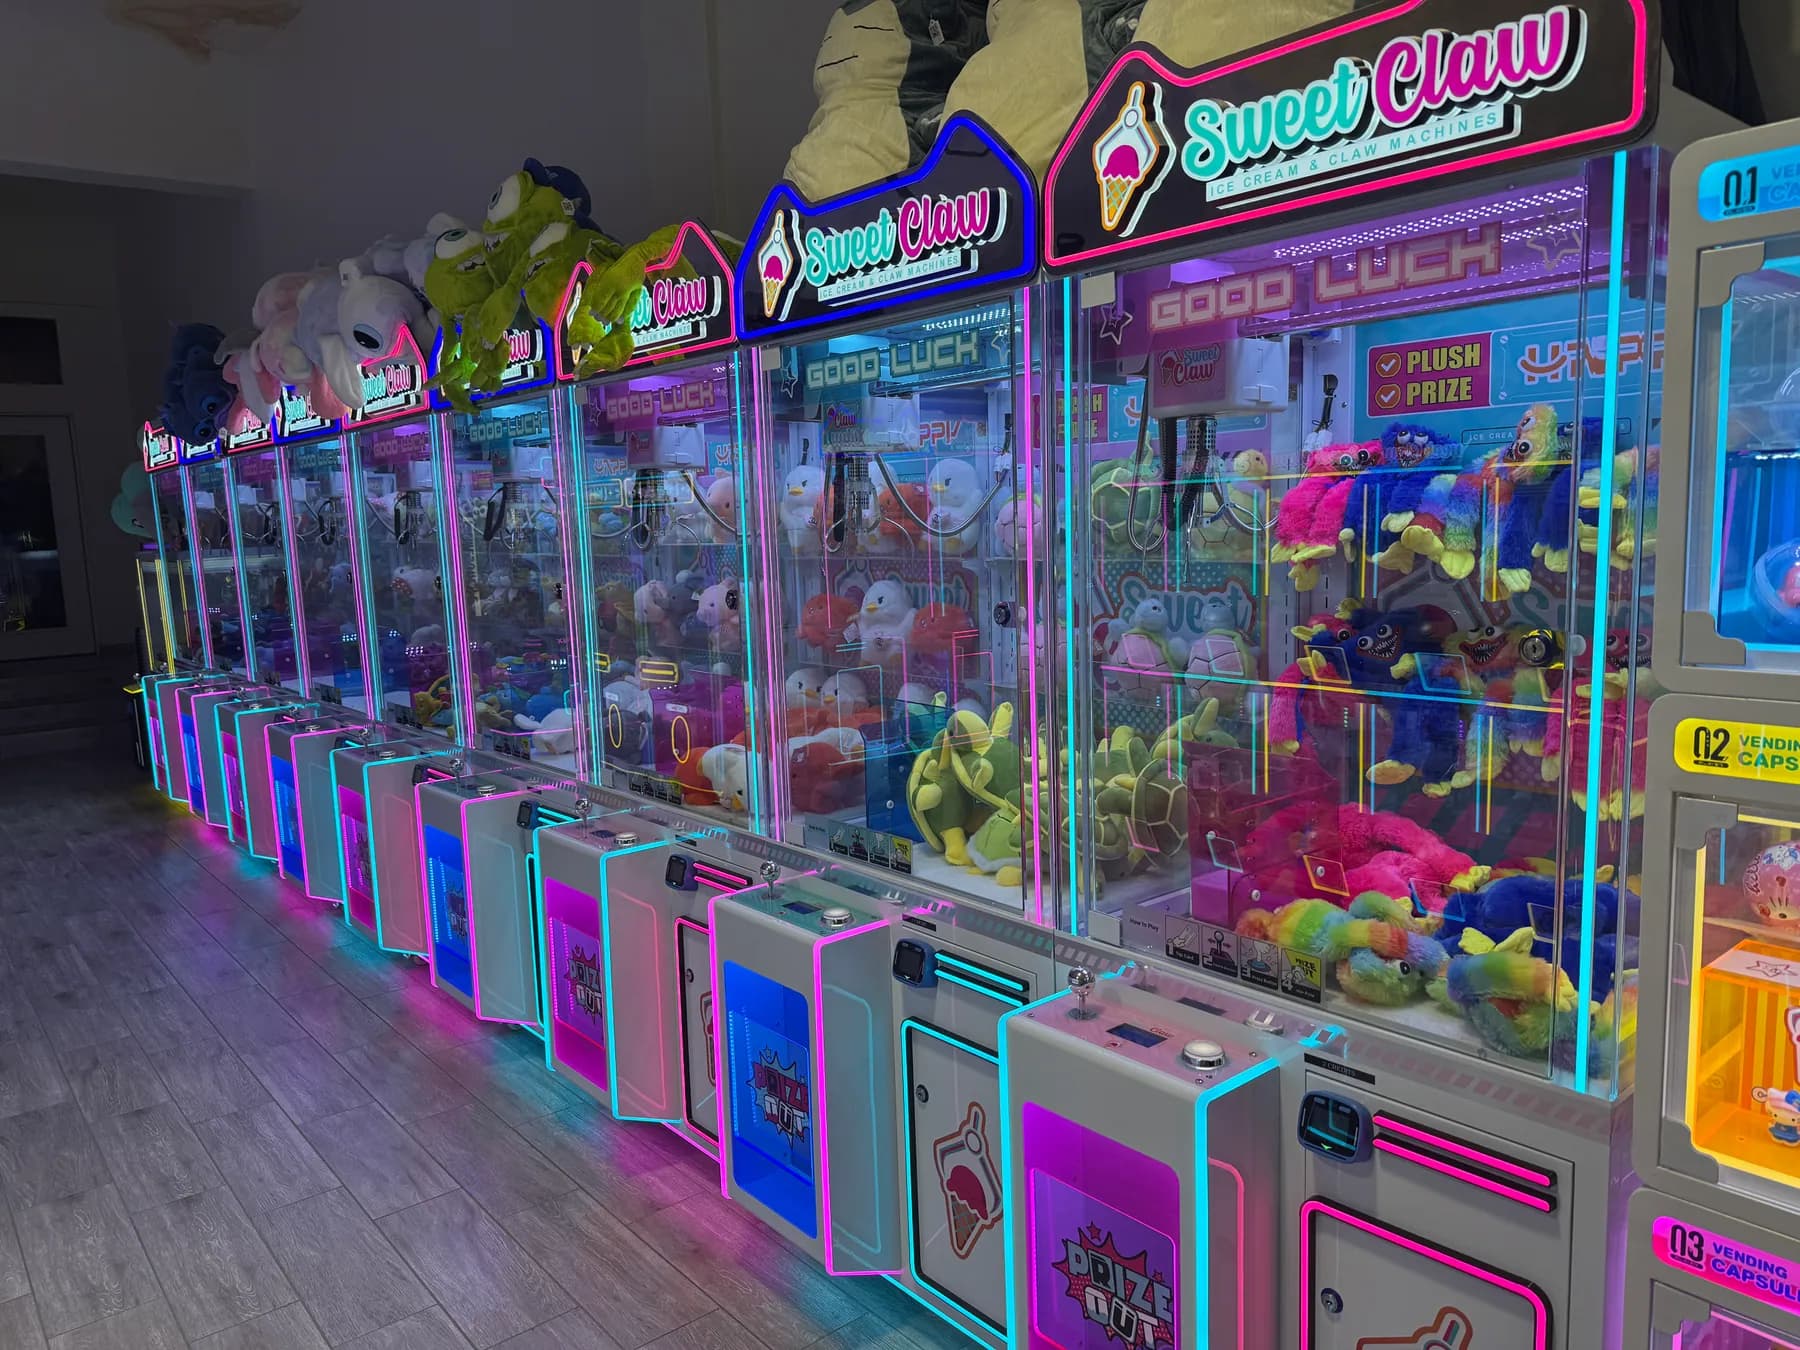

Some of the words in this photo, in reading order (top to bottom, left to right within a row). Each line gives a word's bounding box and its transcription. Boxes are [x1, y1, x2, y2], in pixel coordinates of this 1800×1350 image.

[1182, 57, 1367, 181] Sweet
[1373, 5, 1573, 126] Claw
[1210, 181, 1234, 197] ICE
[1243, 164, 1299, 187] CREAM
[1309, 159, 1319, 171] &
[1328, 143, 1378, 166] CLAW
[1389, 112, 1497, 151] MACHINES
[1723, 165, 1758, 208] 01
[805, 208, 896, 287] Sweet
[899, 187, 991, 261] Claw
[819, 289, 833, 299] ICE
[836, 280, 865, 294] CREAM
[878, 271, 902, 283] CLAW
[907, 255, 960, 276] MACHINES
[1149, 264, 1295, 331] GOOD
[1314, 223, 1503, 302] LUCK
[653, 276, 707, 328] Claw
[805, 350, 881, 389] GOOD
[889, 329, 980, 379] LUCK
[1171, 362, 1217, 386] Claw
[1183, 344, 1222, 366] Sweet
[1406, 341, 1482, 374] PLUSH
[1406, 376, 1474, 406] PRIZE
[1488, 430, 1514, 441] CREA
[1693, 726, 1730, 762] 02
[1737, 751, 1799, 772] CAPS
[764, 1094, 809, 1141] OUT
[1670, 1224, 1704, 1262] 03
[1712, 1241, 1788, 1280] VENDING
[1066, 1239, 1174, 1324] PRIZE
[1084, 1285, 1160, 1350] OUT
